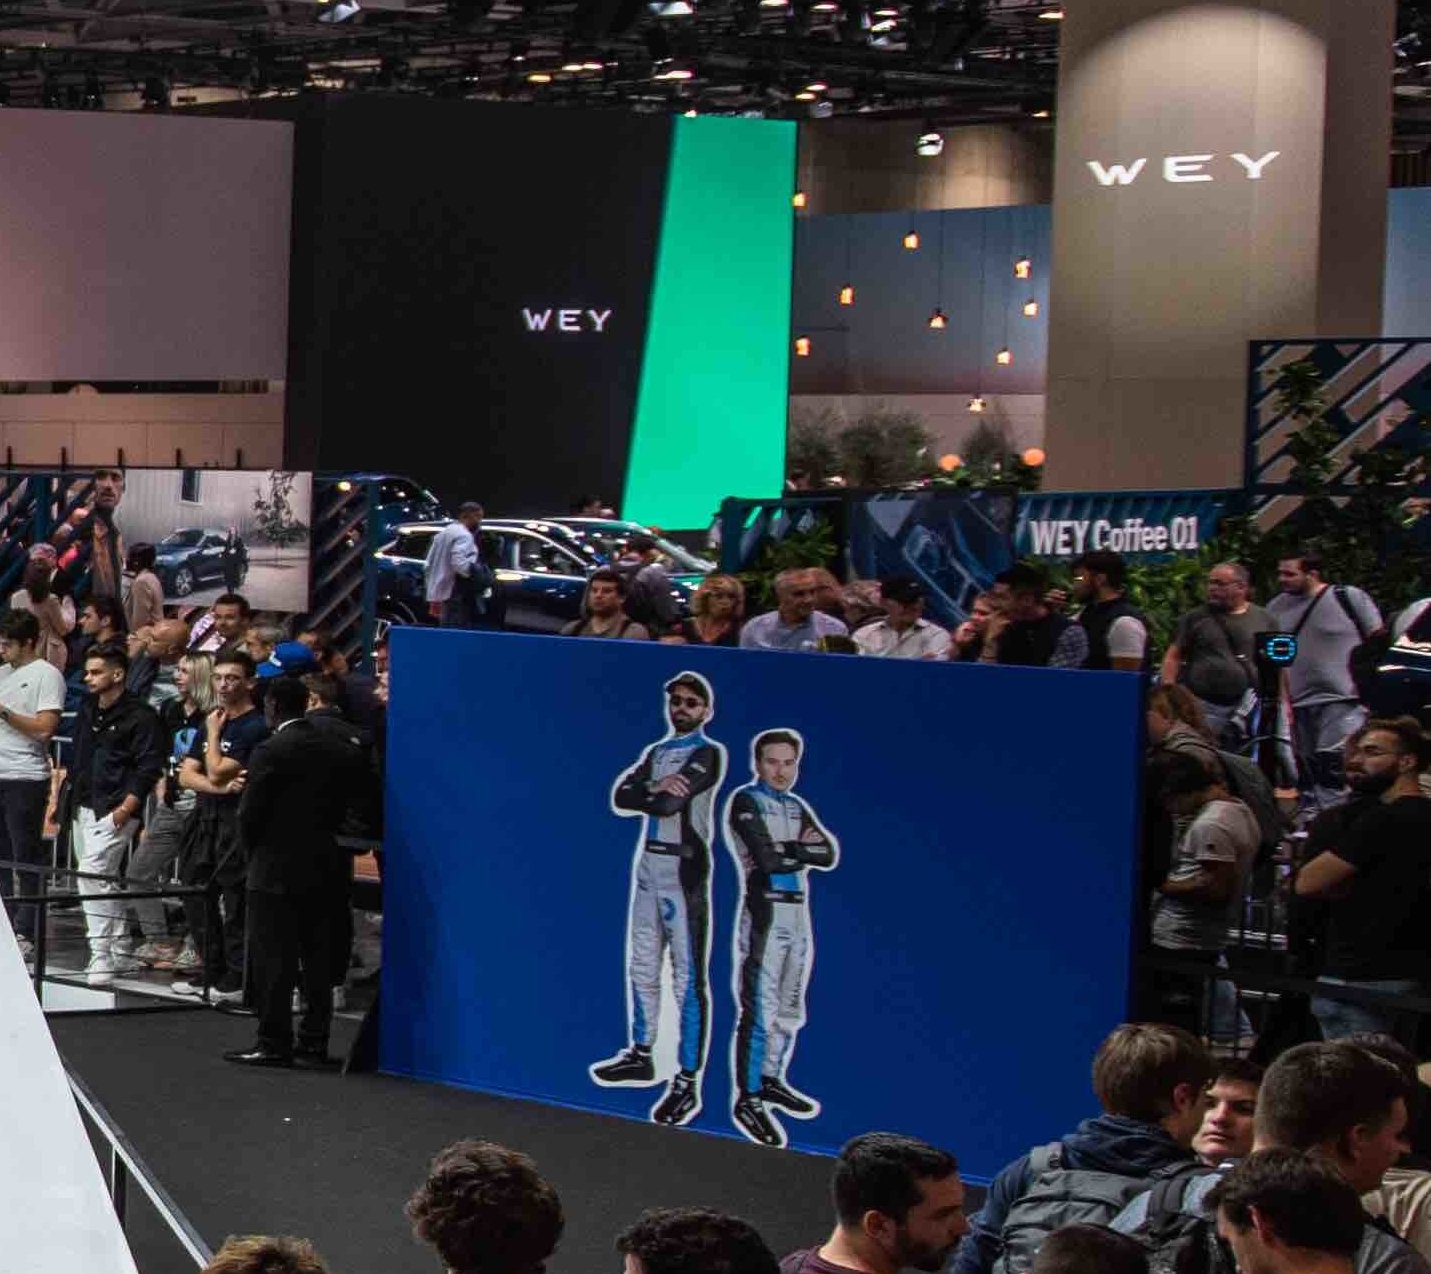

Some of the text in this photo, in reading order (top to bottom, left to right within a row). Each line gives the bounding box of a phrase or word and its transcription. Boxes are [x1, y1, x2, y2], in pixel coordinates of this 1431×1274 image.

[1087, 151, 1281, 185] WEY
[521, 308, 612, 332] WEY
[1029, 519, 1199, 556] WEY Coffee 01
